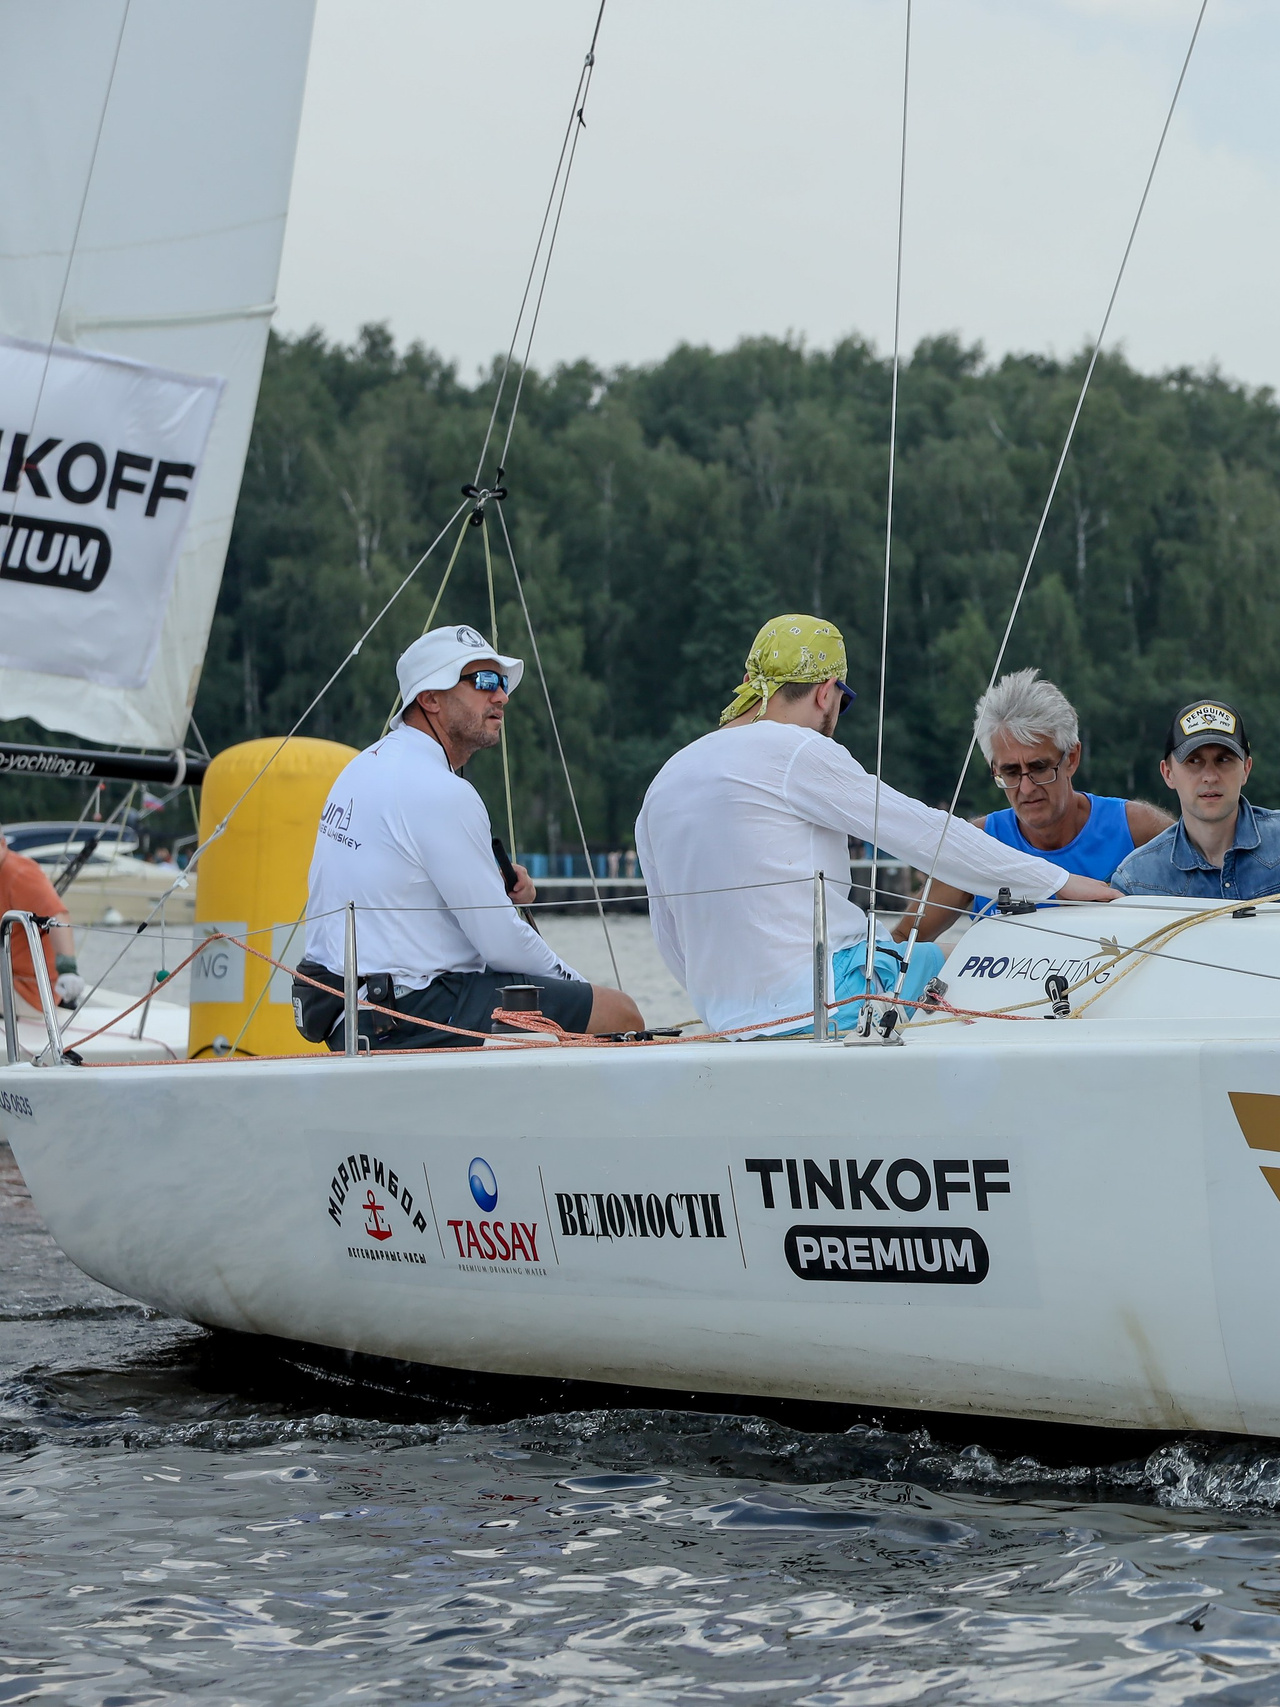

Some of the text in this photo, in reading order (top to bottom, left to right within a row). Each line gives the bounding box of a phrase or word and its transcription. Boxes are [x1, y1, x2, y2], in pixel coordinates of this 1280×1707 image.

[0, 430, 196, 518] KOFF
[1186, 706, 1231, 724] PENGUINS
[326, 829, 362, 850] WHISKEY
[957, 955, 1115, 984] PROYACHTING
[10, 1092, 33, 1117] 0635
[328, 1153, 428, 1234] МОРПРИБОР
[745, 1157, 1011, 1212] TINKOFF
[554, 1193, 727, 1244] ВЕДОМОСТИ
[347, 1246, 427, 1264] ЛЕГЕНДАРНЫЕ ЧАСЫ
[447, 1220, 540, 1262] TASSAY
[795, 1236, 977, 1272] PREMIUM
[458, 1263, 547, 1276] PREMIUM DRINKING WATER
